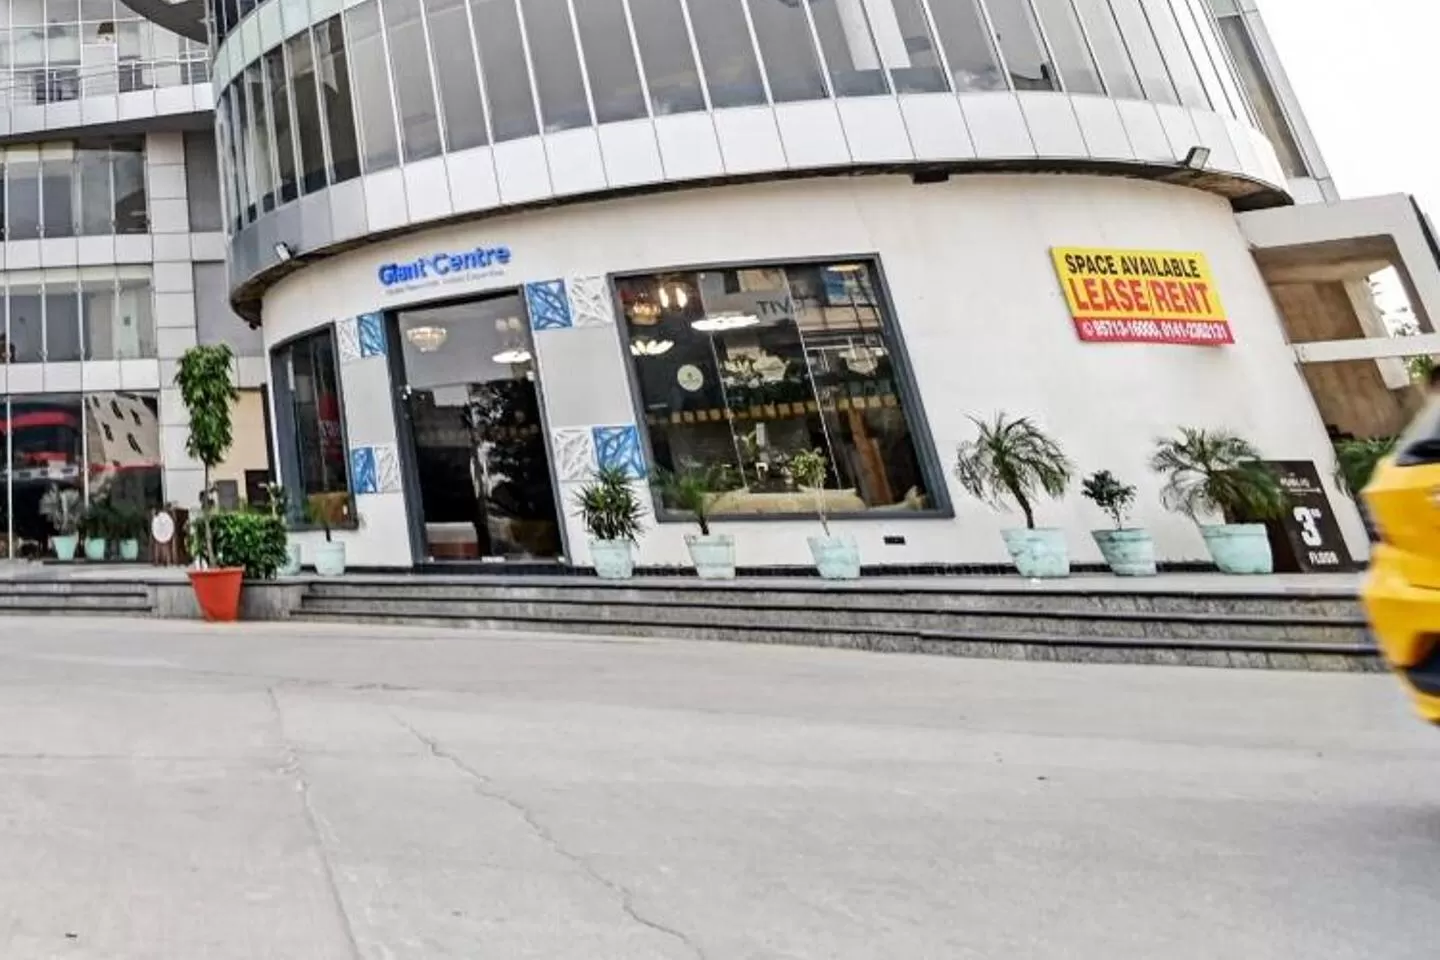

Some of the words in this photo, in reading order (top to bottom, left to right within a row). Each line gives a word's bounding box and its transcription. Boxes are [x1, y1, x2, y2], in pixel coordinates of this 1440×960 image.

[433, 244, 511, 276] Centre
[1065, 253, 1118, 275] SPACE
[1120, 256, 1201, 278] AVAILABLE
[1068, 278, 1212, 315] LEASE/RENT
